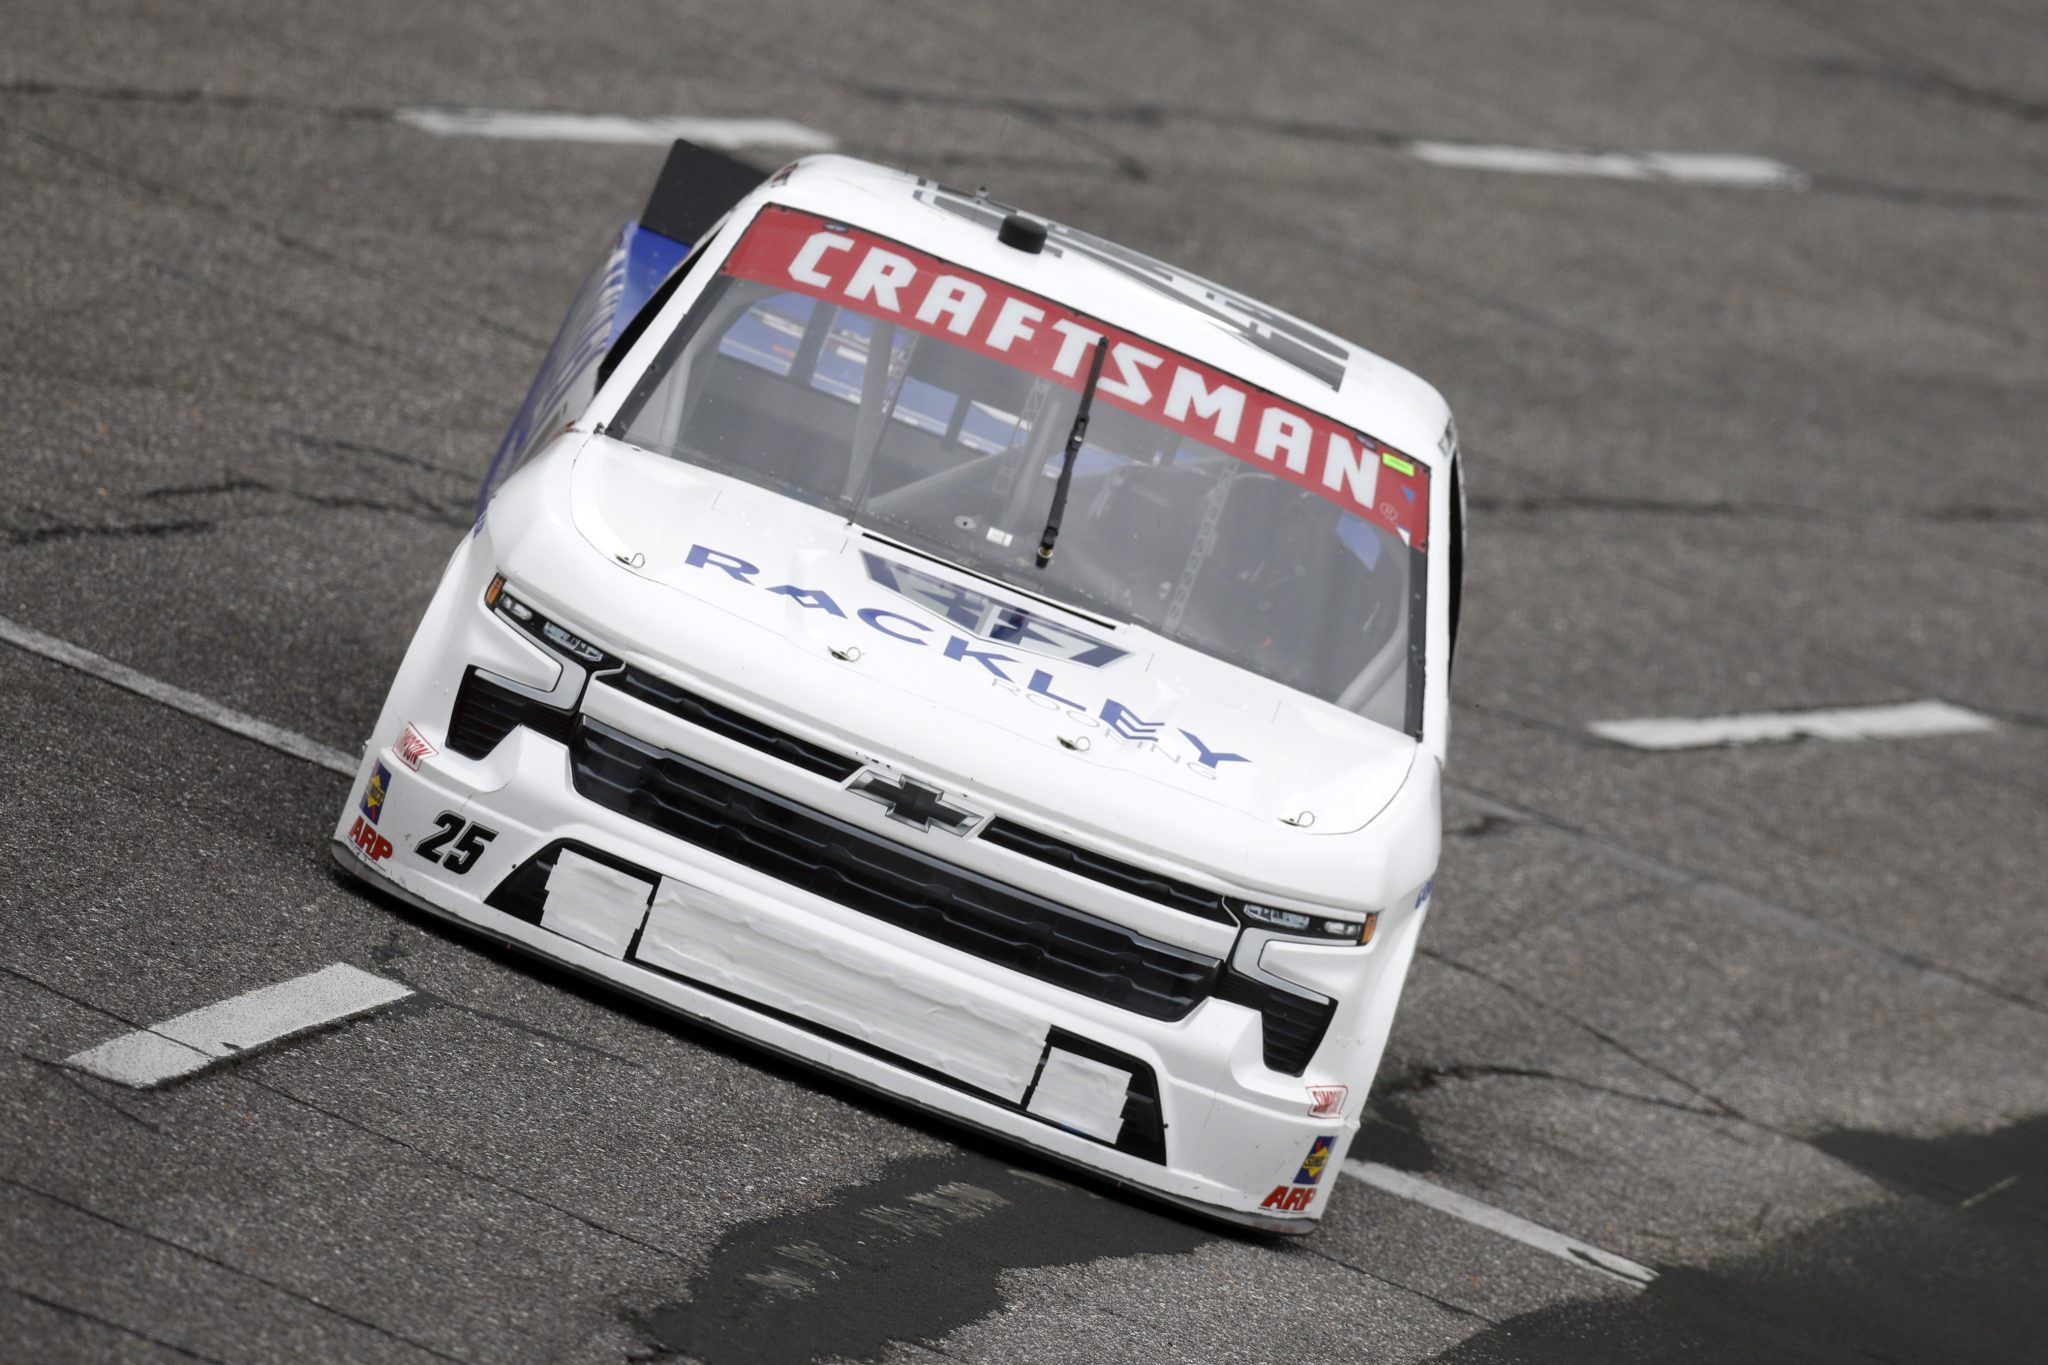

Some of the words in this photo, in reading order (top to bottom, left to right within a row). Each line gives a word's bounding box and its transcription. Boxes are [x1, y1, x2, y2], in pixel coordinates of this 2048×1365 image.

[787, 230, 1380, 511] CRAFTSMAN
[685, 544, 1252, 769] RACKLEY
[349, 815, 393, 862] ARP
[414, 810, 499, 875] 25
[1261, 1185, 1317, 1211] ARP
